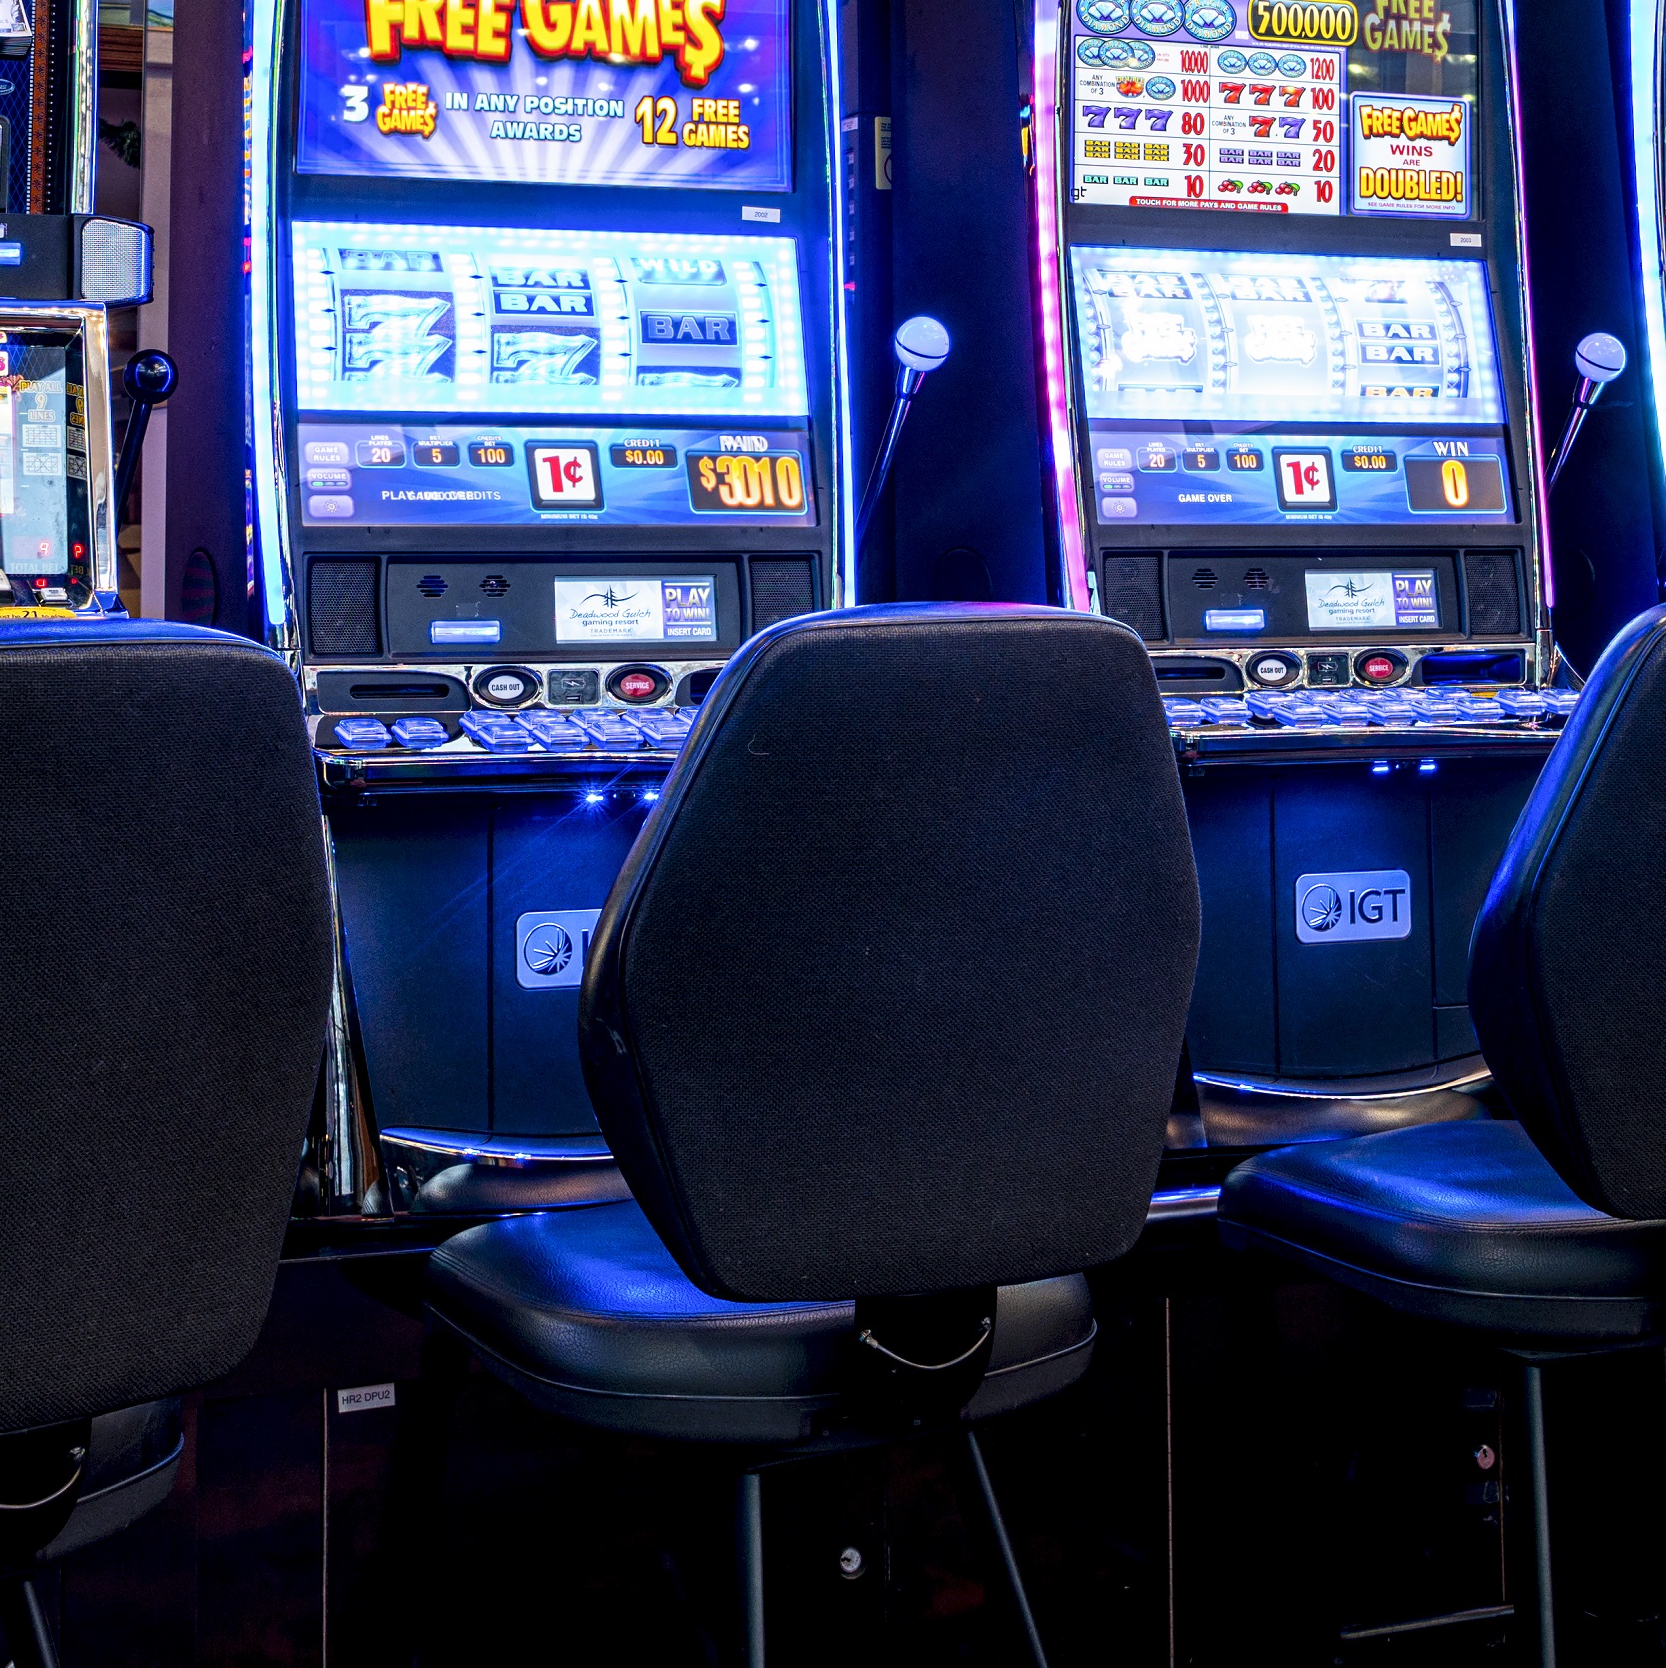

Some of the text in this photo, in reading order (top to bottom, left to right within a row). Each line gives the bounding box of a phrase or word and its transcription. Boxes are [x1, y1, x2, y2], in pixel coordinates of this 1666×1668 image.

[1310, 57, 1334, 81] 1200
[1181, 79, 1210, 103] 1000
[342, 85, 370, 124] 3
[444, 92, 625, 118] IN ANY POSITION
[691, 99, 741, 124] FREE
[490, 121, 582, 143] AWARDS
[634, 96, 679, 147] 12
[1181, 112, 1205, 135] 80
[1359, 104, 1402, 140] FREE
[682, 123, 750, 150] GAMES
[1183, 143, 1205, 167] 30
[1312, 149, 1335, 172] 20
[1390, 144, 1434, 157] WINS
[1402, 158, 1421, 167] ARE
[1315, 180, 1333, 203] 10
[1359, 167, 1464, 203] DOUBLED!
[1201, 201, 1218, 209] PAYS
[1260, 204, 1282, 212] RULES
[647, 315, 732, 339] BAR
[1362, 322, 1432, 340] BAR
[1433, 441, 1469, 457] WIN
[542, 455, 584, 494] 1¢
[1178, 493, 1233, 504] GAME OVER
[665, 588, 710, 608] PLAY
[490, 681, 521, 694] CASH OUT
[625, 682, 650, 690] SERVICE
[1348, 888, 1406, 925] IGT
[342, 1390, 390, 1405] HR2 DPU2
